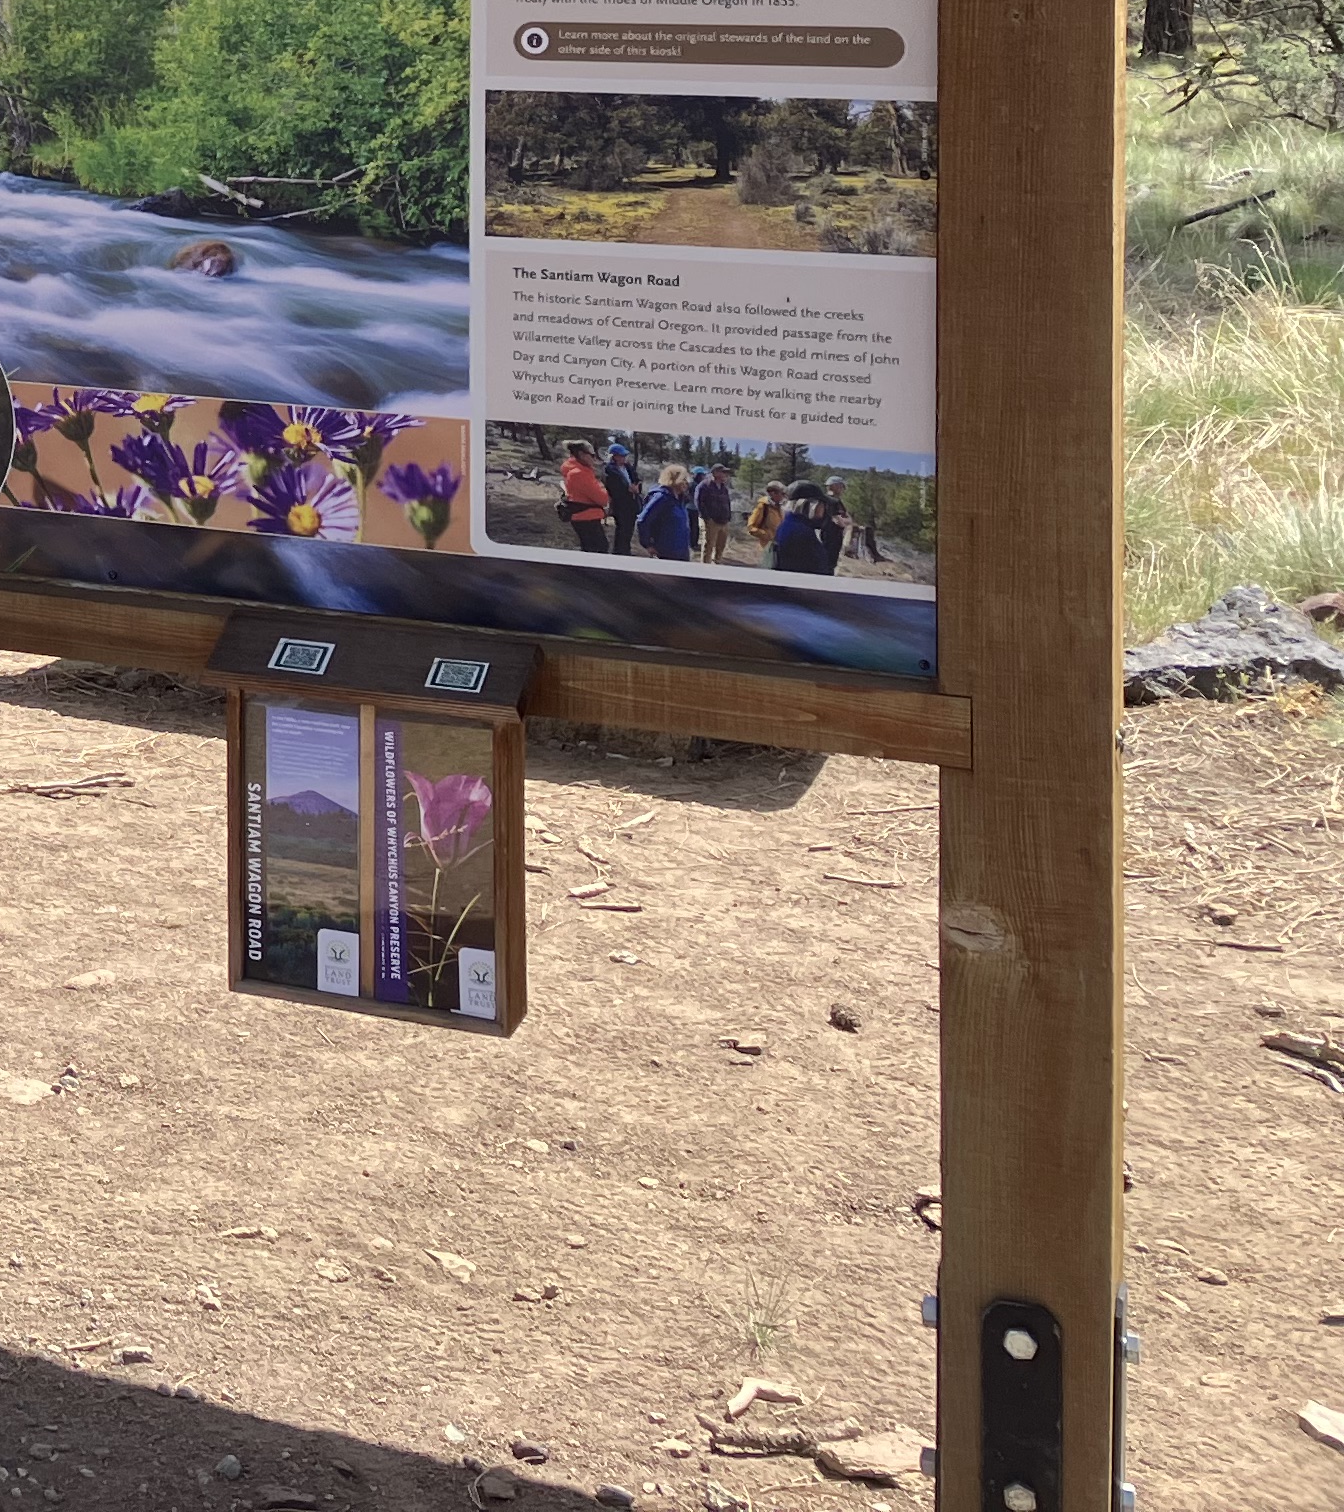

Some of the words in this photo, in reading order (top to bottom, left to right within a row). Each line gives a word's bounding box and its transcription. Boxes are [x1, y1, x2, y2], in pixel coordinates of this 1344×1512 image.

[511, 268, 537, 279] The
[540, 269, 594, 282] Santiam
[596, 272, 643, 287] Wagon
[647, 275, 680, 286] Road
[384, 732, 396, 808] WILDFLOWERS
[247, 782, 261, 853] SANTIAM
[386, 810, 396, 825] OF
[387, 827, 398, 880] WHYCHUS
[248, 858, 262, 915] WAGON
[389, 881, 399, 924] CANYON
[248, 920, 262, 961] ROAD
[390, 927, 400, 980] PRESERVE
